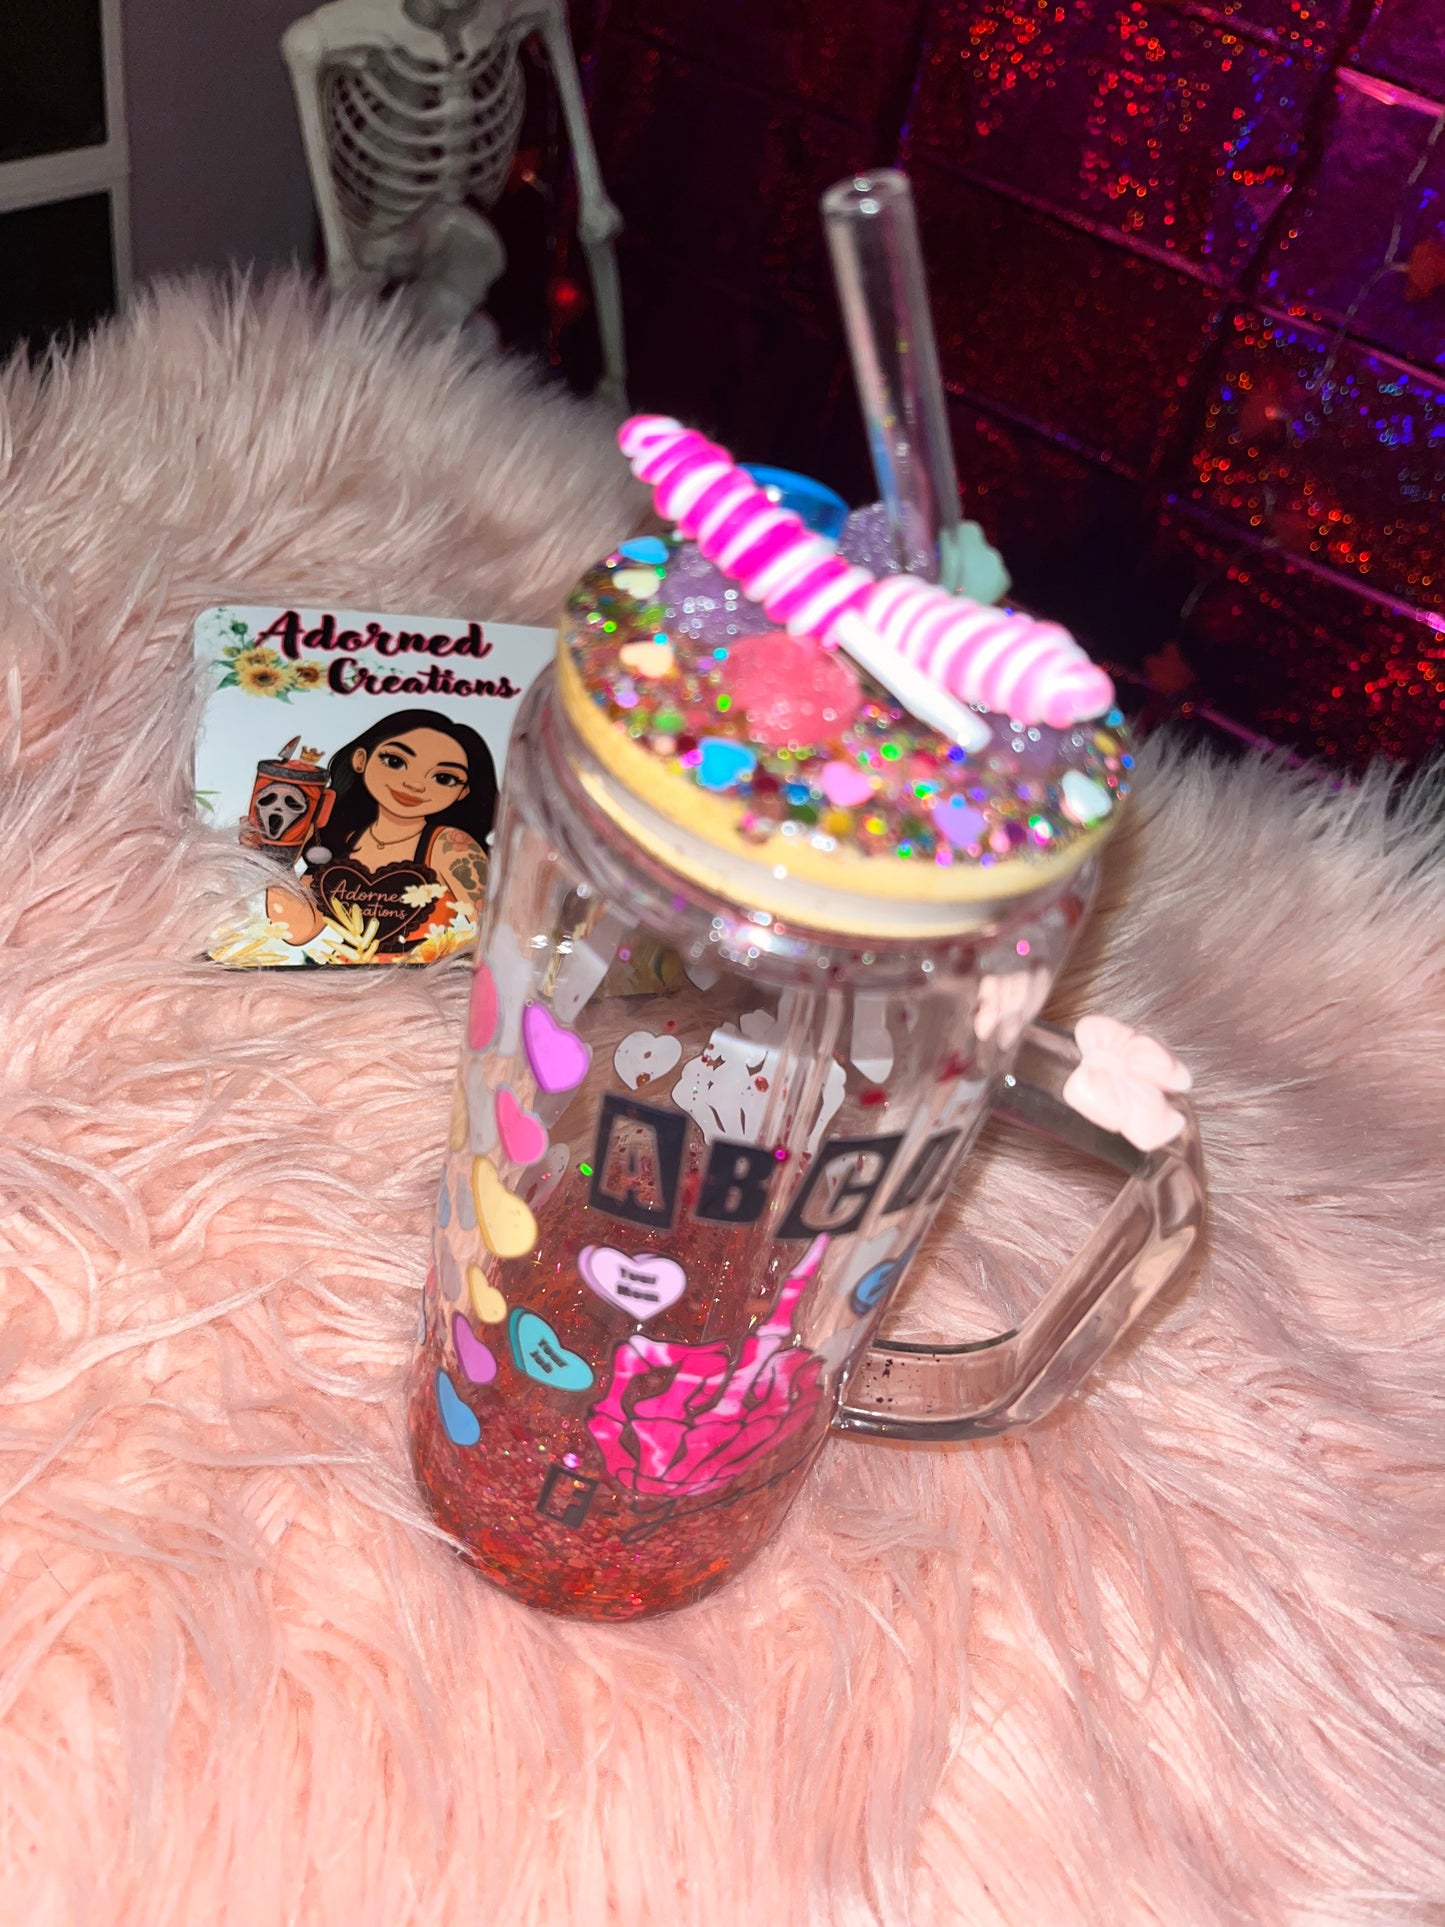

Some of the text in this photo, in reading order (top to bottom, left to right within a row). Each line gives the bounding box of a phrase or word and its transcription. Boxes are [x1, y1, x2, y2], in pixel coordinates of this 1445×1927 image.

[254, 610, 493, 660] Adorned
[326, 657, 522, 699] Creations
[330, 879, 405, 903] Adorne
